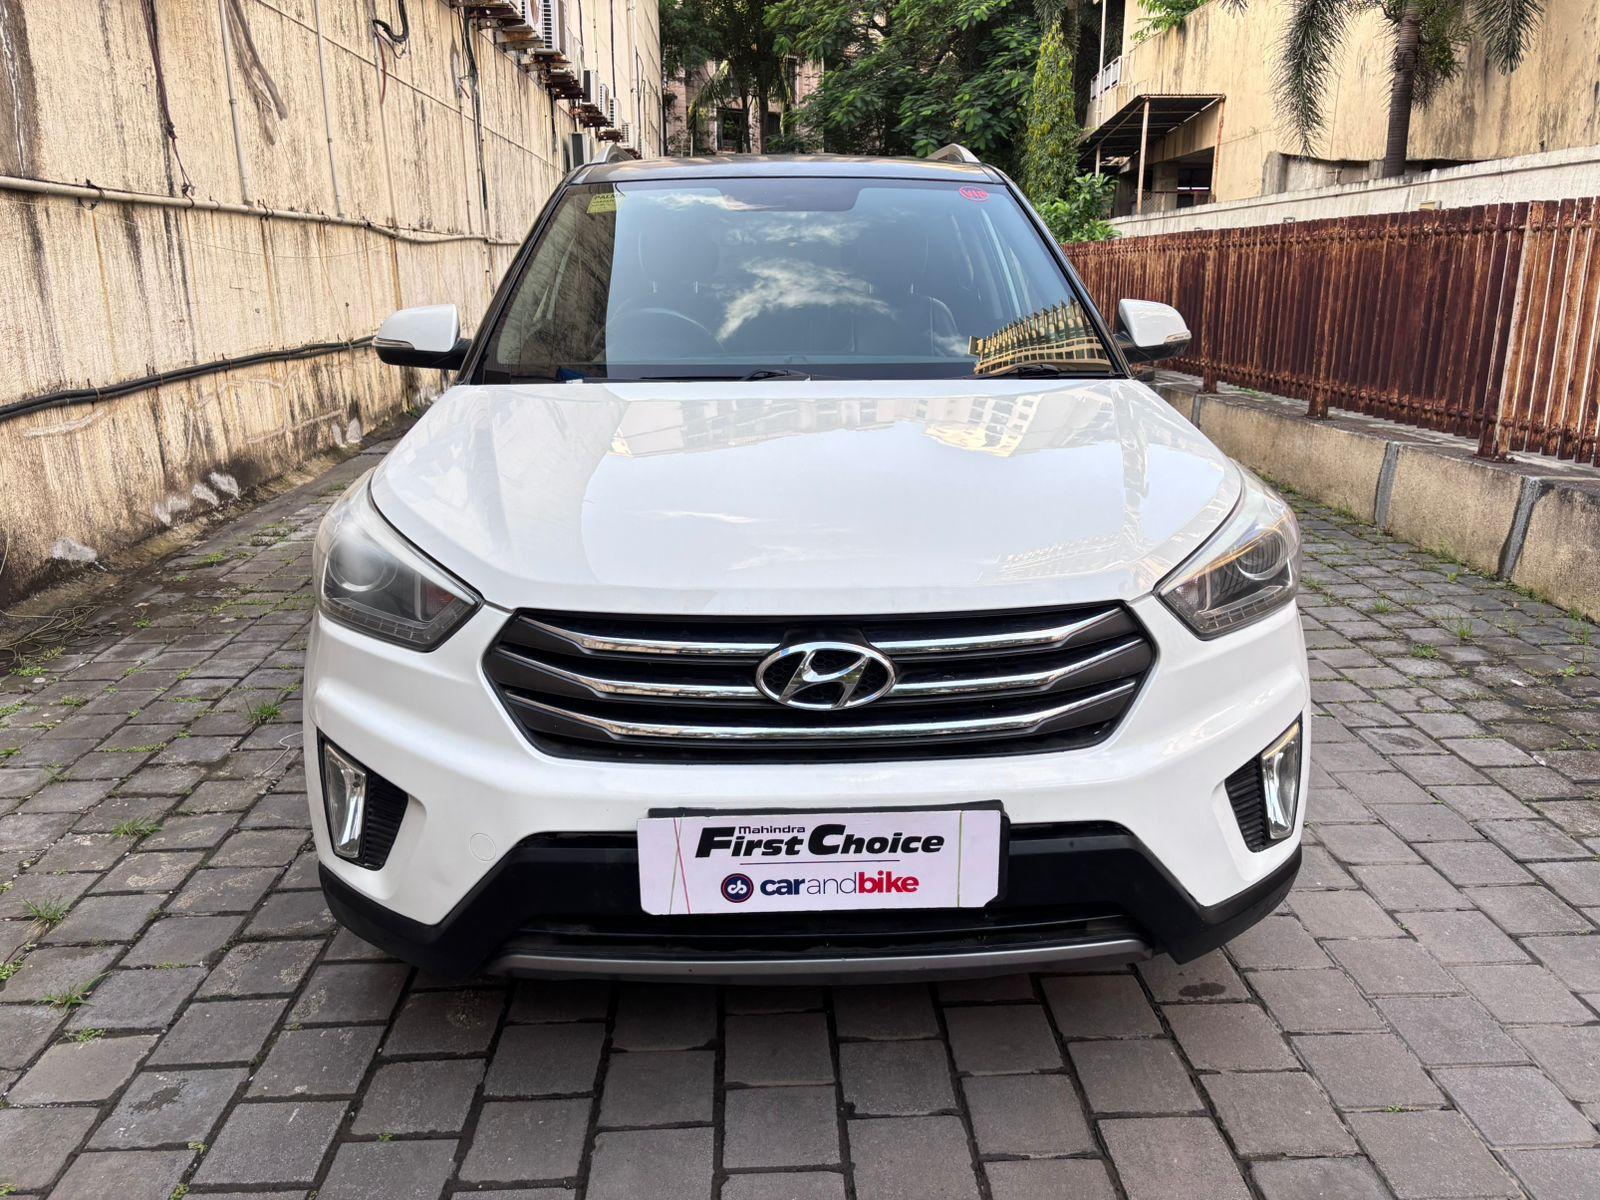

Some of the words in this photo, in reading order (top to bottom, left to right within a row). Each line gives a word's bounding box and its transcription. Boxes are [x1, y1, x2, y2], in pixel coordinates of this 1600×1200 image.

[738, 825, 806, 834] Mahindra
[695, 826, 805, 858] First
[808, 824, 945, 856] Choice
